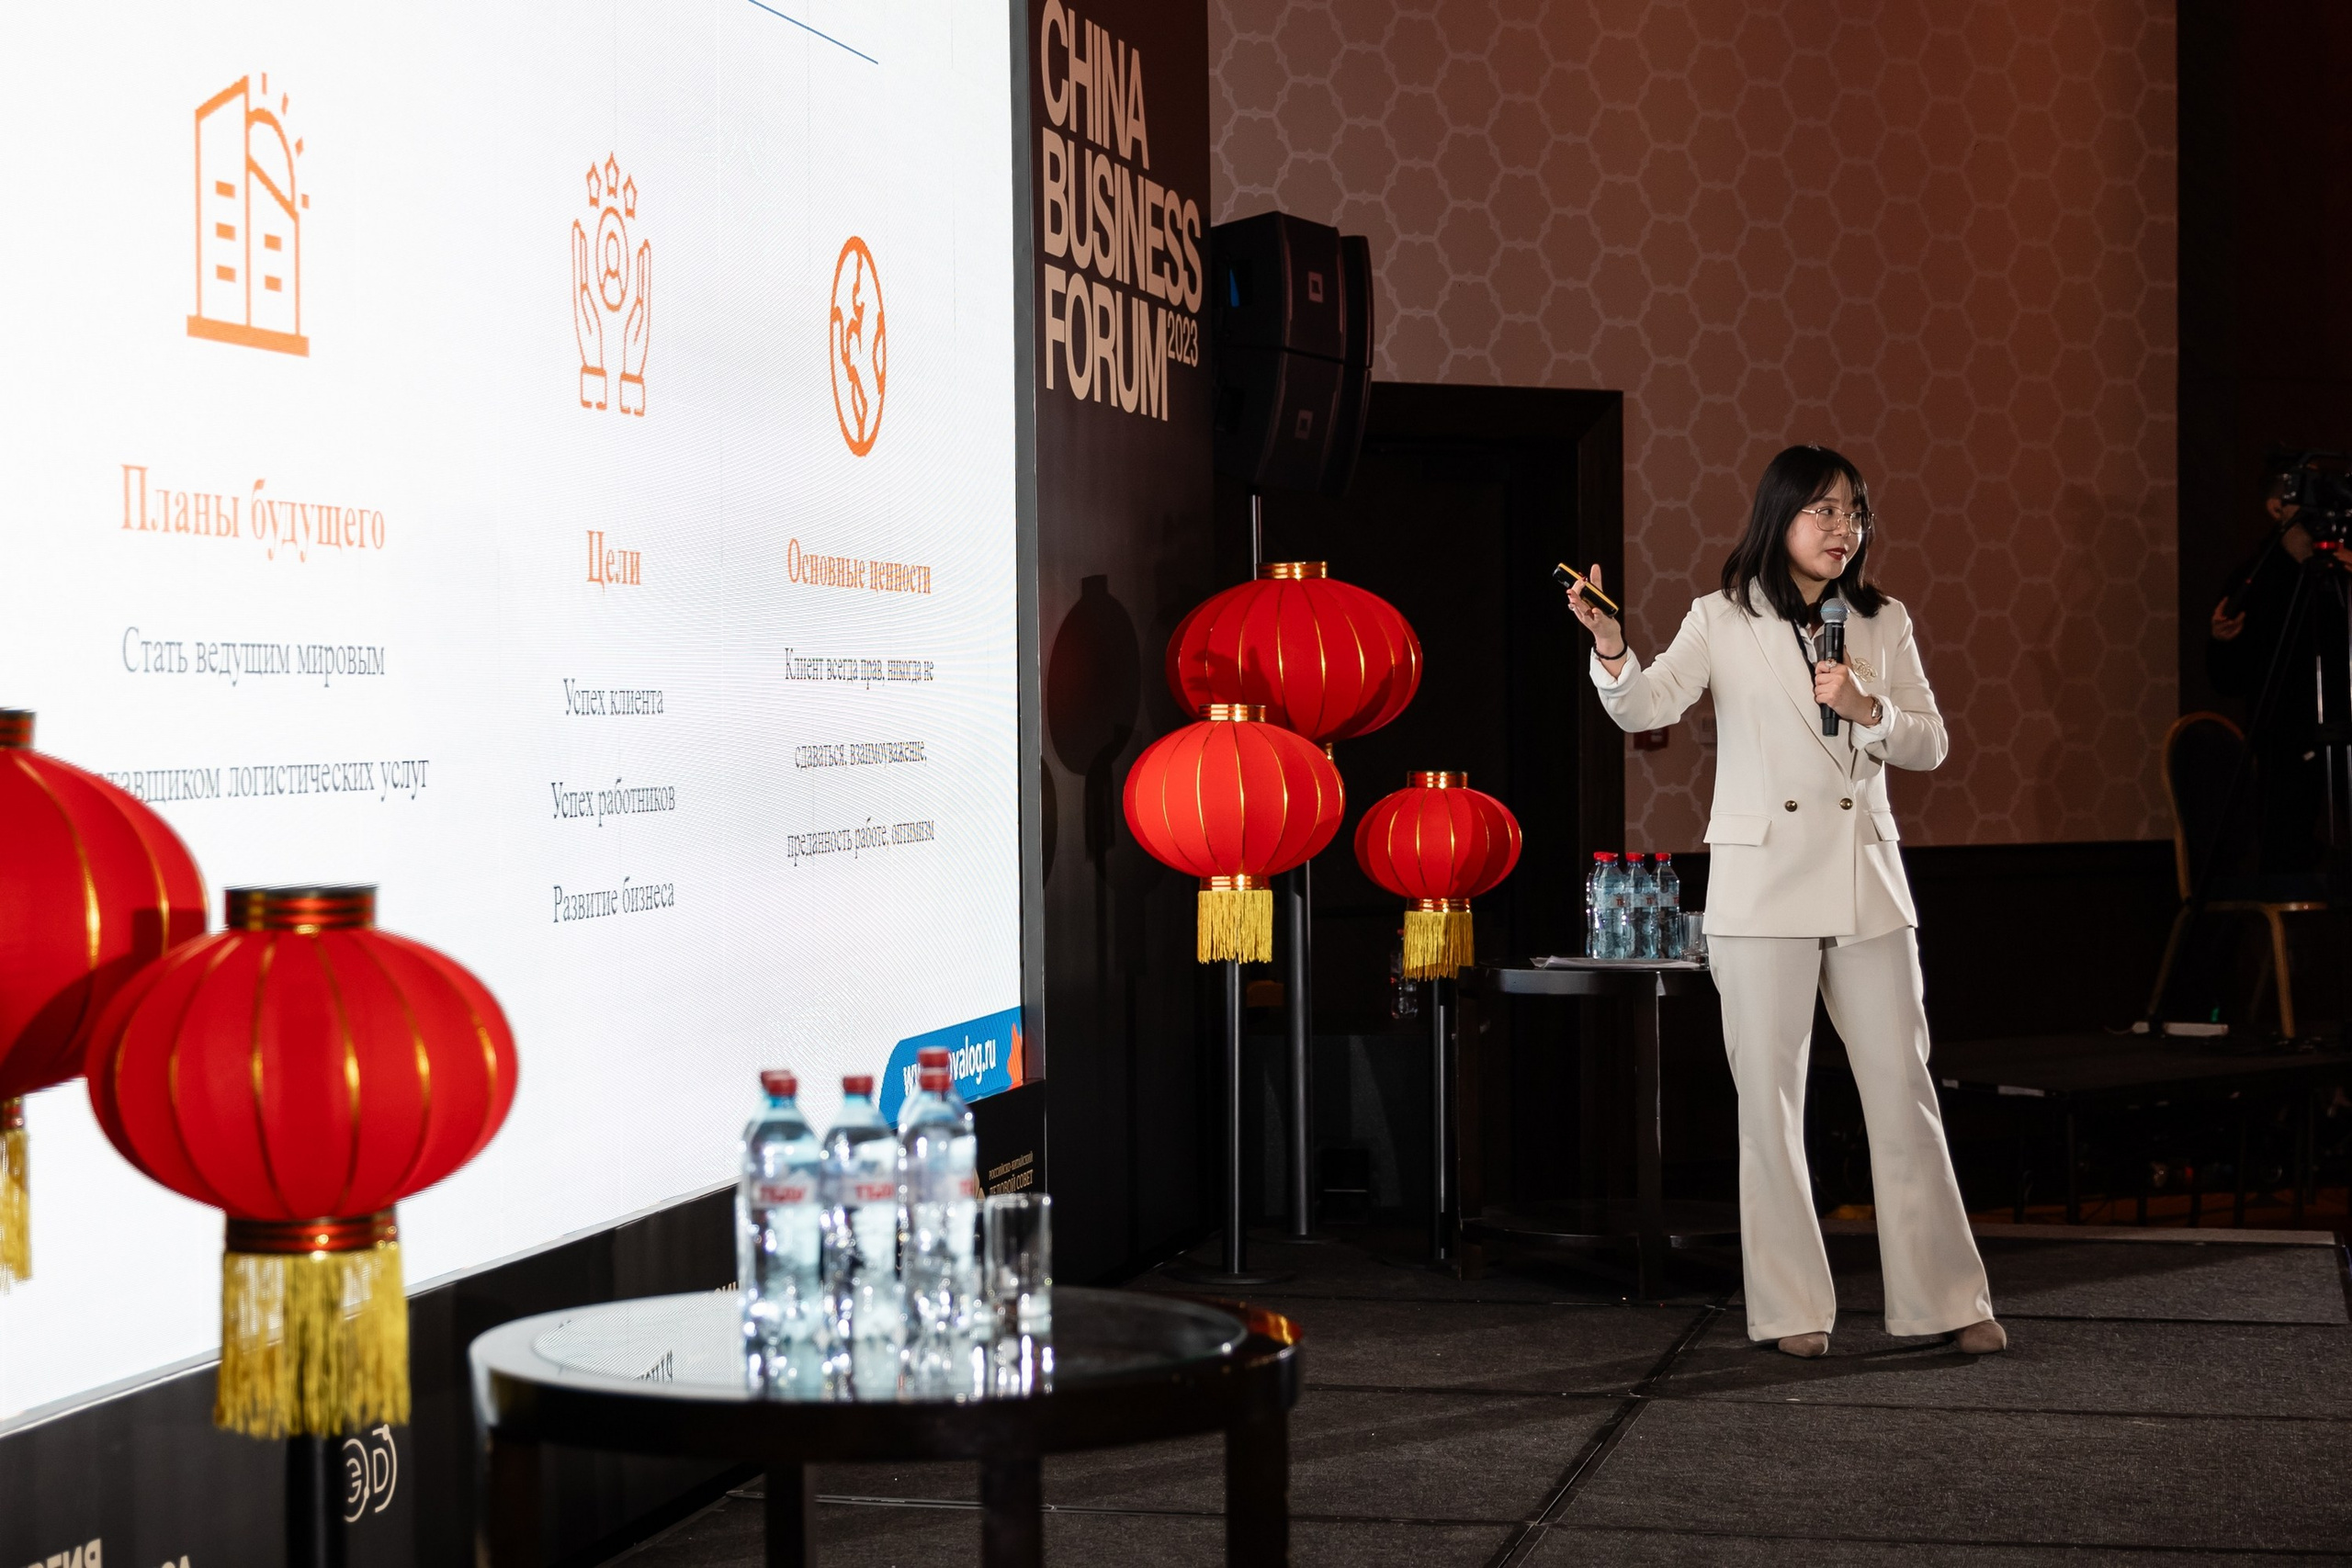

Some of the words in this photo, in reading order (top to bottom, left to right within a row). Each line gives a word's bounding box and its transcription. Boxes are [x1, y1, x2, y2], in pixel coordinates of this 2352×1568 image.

[1041, 0, 1149, 171] CHINA
[1043, 127, 1202, 314] BUSINESS
[1045, 263, 1168, 422] FORUM
[1167, 310, 1199, 367] 2023
[120, 463, 240, 538] Планы
[251, 478, 385, 563] будущего
[586, 530, 641, 593] Цели
[787, 538, 865, 589] Основные
[869, 558, 932, 594] ценности
[122, 626, 188, 674] Стать
[196, 641, 290, 688] ведущим
[297, 644, 385, 689] мировым
[785, 648, 824, 681] Клиент
[827, 658, 858, 685] всегда
[888, 659, 922, 685] никогда
[923, 660, 934, 682] не
[563, 678, 606, 716] Успех
[610, 689, 664, 716] клиента
[227, 761, 375, 798] логистических
[380, 760, 430, 802] услуг
[551, 782, 594, 819] Успех
[598, 778, 675, 828] работников
[787, 829, 853, 867] преданность
[891, 820, 934, 850] оптимизм
[553, 885, 618, 923] Развитие
[623, 876, 674, 914] бизнеса
